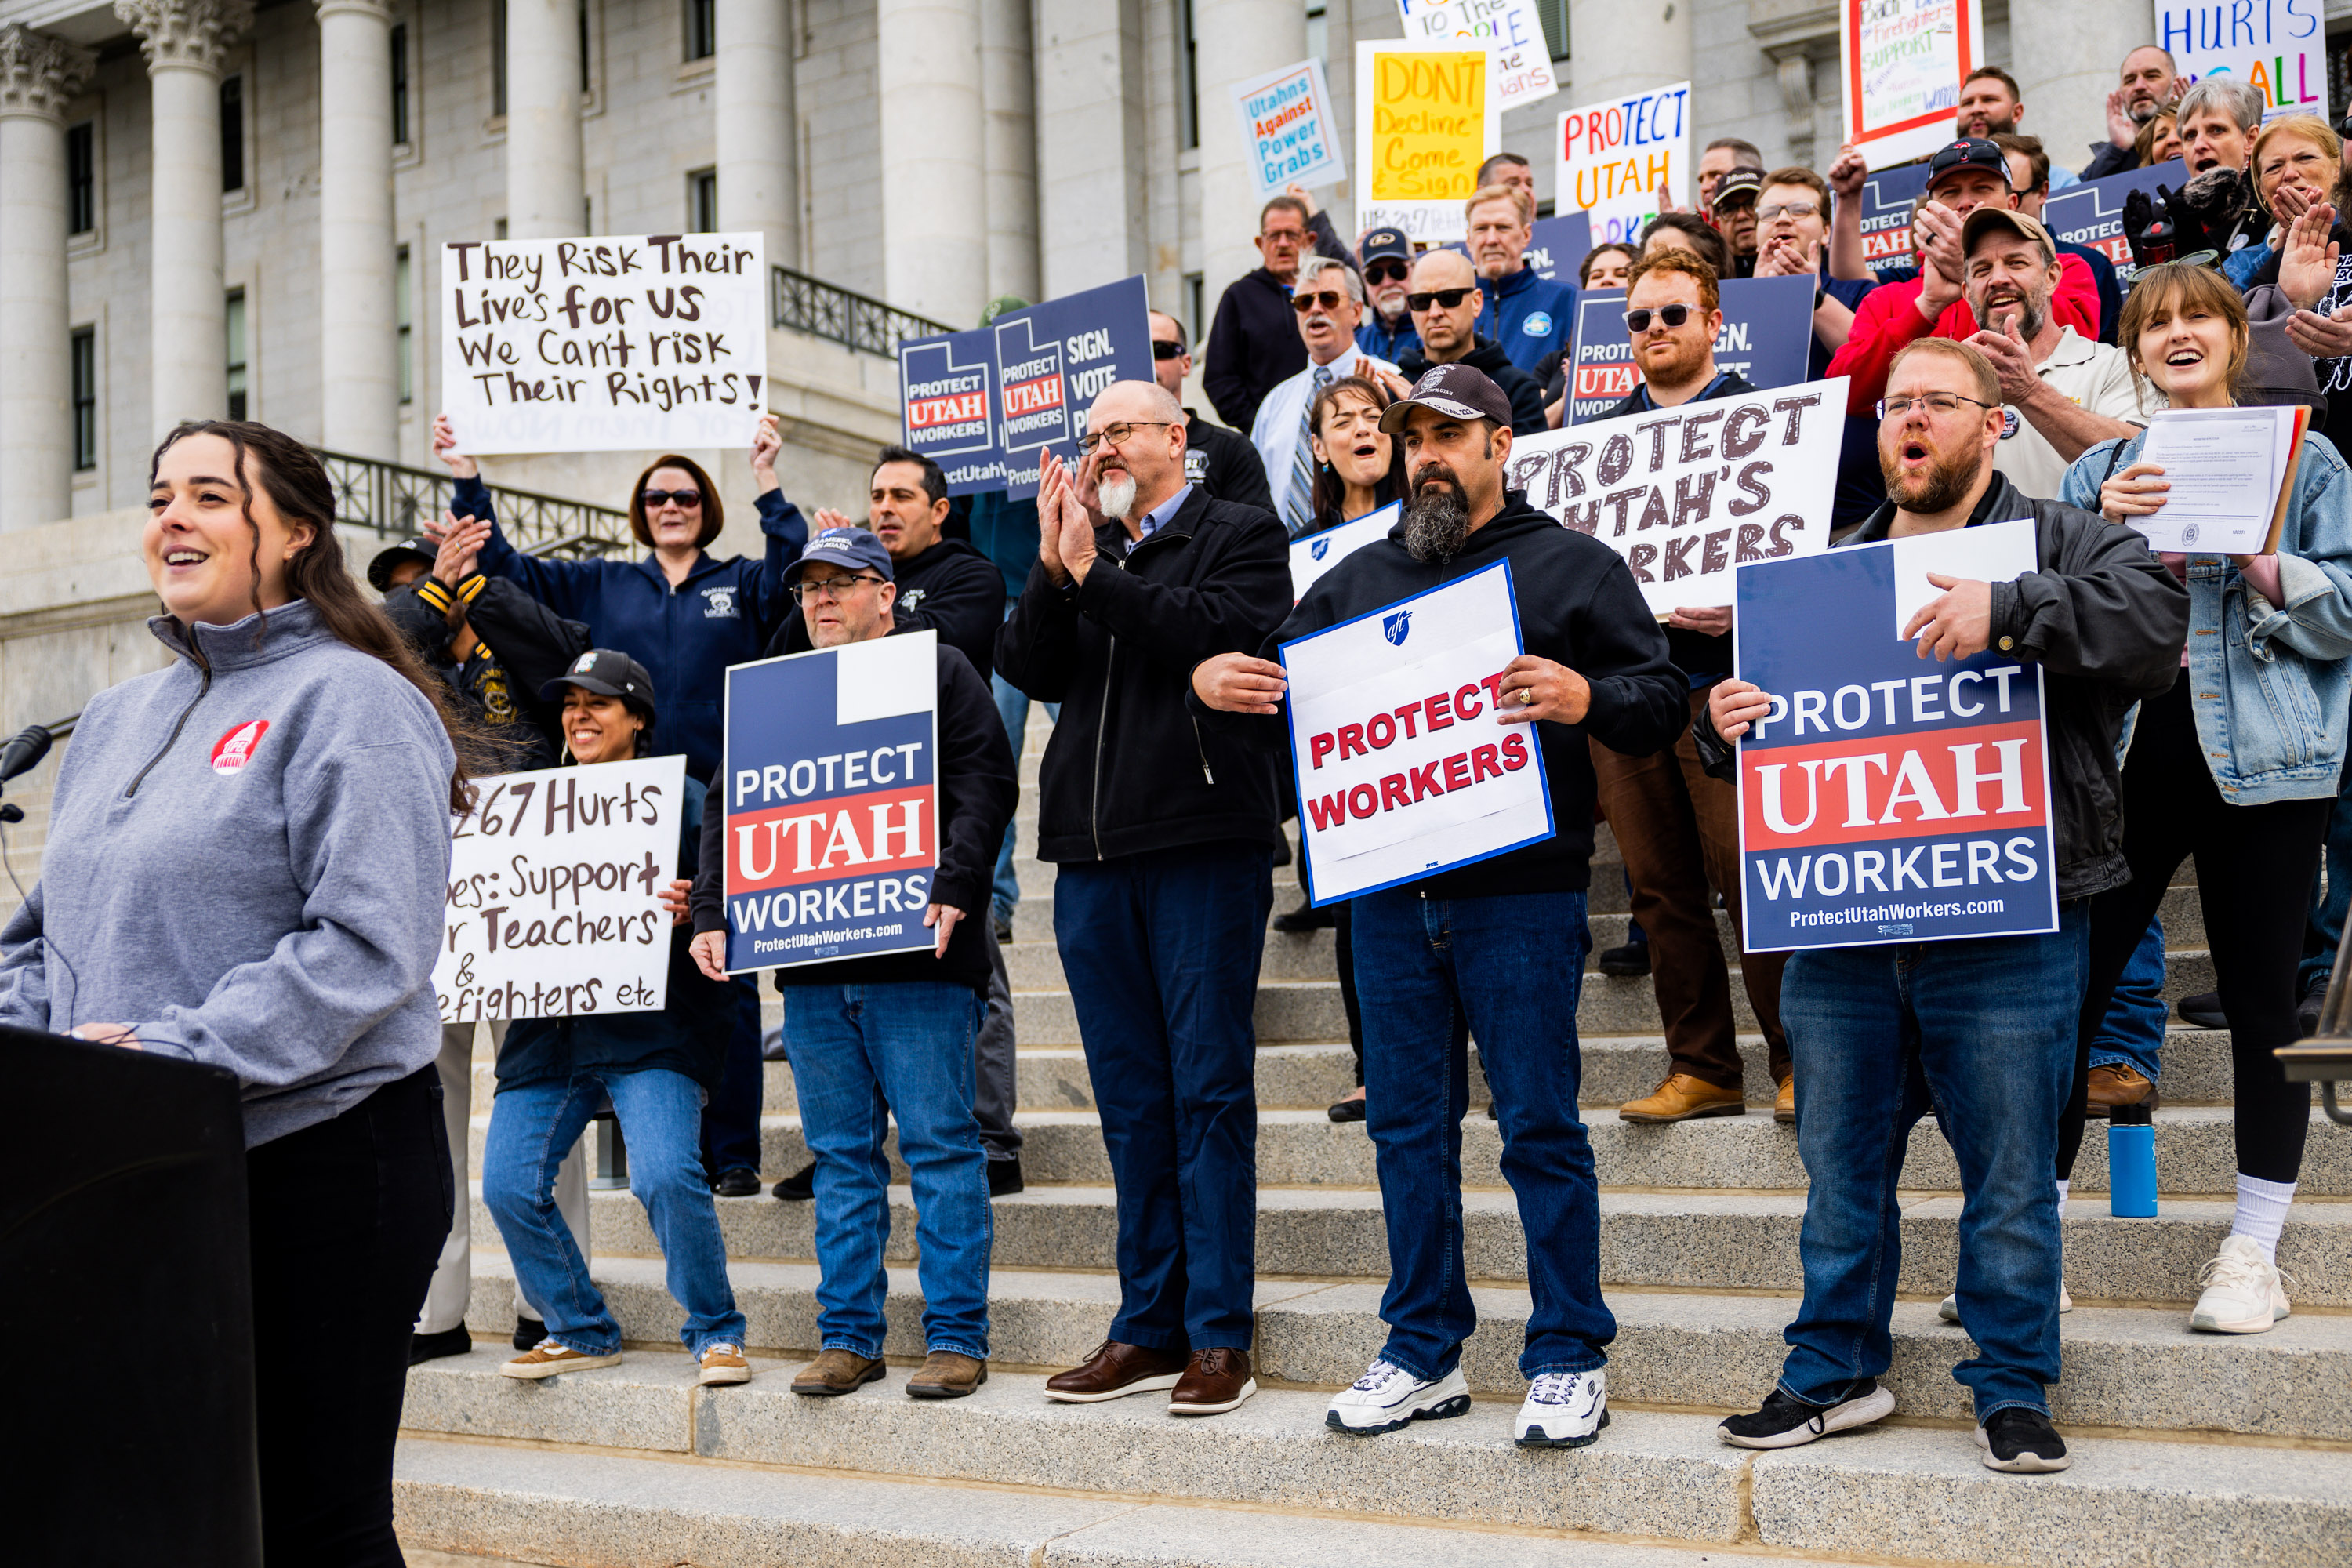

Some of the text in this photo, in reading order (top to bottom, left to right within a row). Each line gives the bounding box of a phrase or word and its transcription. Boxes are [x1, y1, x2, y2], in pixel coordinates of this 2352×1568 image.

[1861, 28, 1935, 73] SUPPORT
[1249, 77, 1308, 118] Utahns
[2249, 53, 2319, 109] ALL
[1256, 96, 1313, 139] Against
[1565, 89, 1687, 161] PROTECT
[1259, 119, 1316, 162] Power
[1385, 136, 1466, 172] Come
[1264, 143, 1324, 183] Grabs
[1576, 150, 1670, 210] UTAH
[1860, 209, 1911, 234] OTECT
[1861, 229, 1913, 258] TAH
[447, 234, 755, 294] They Risk Their
[455, 288, 549, 329] Lives
[558, 284, 636, 329] for
[457, 332, 521, 368] We
[537, 329, 637, 368] Can't
[1066, 328, 1115, 365] SIGN.
[1580, 343, 1635, 362] PROT
[909, 375, 982, 400] PROTECT
[1002, 354, 1057, 384] PROTECT
[1070, 365, 1117, 401] VOTE
[472, 371, 764, 413] Their Rights!
[909, 394, 984, 428] UTAH
[1004, 377, 1062, 416] UTAH
[910, 420, 985, 445] WORKERS
[1007, 408, 1064, 435] WORKERS
[1510, 392, 1821, 510] PROTECT
[1563, 461, 1774, 538] UTAH'S
[1627, 514, 1805, 585] RKERS
[1310, 670, 1504, 770] PROTECT
[1755, 665, 2022, 740] PROTECT
[736, 742, 923, 808] PROTECT
[1307, 733, 1529, 833] WORKERS
[1755, 738, 2032, 835] UTAH
[544, 777, 662, 837] Hurts
[735, 798, 926, 881] UTAH
[507, 851, 661, 912] Support
[1755, 836, 2038, 901] WORKERS
[733, 874, 928, 935] WORKERS
[1790, 897, 2005, 927] ProtectUtahWorkers.com
[479, 906, 658, 954] Teachers
[753, 921, 902, 954] ProtectUtahWorkers.com
